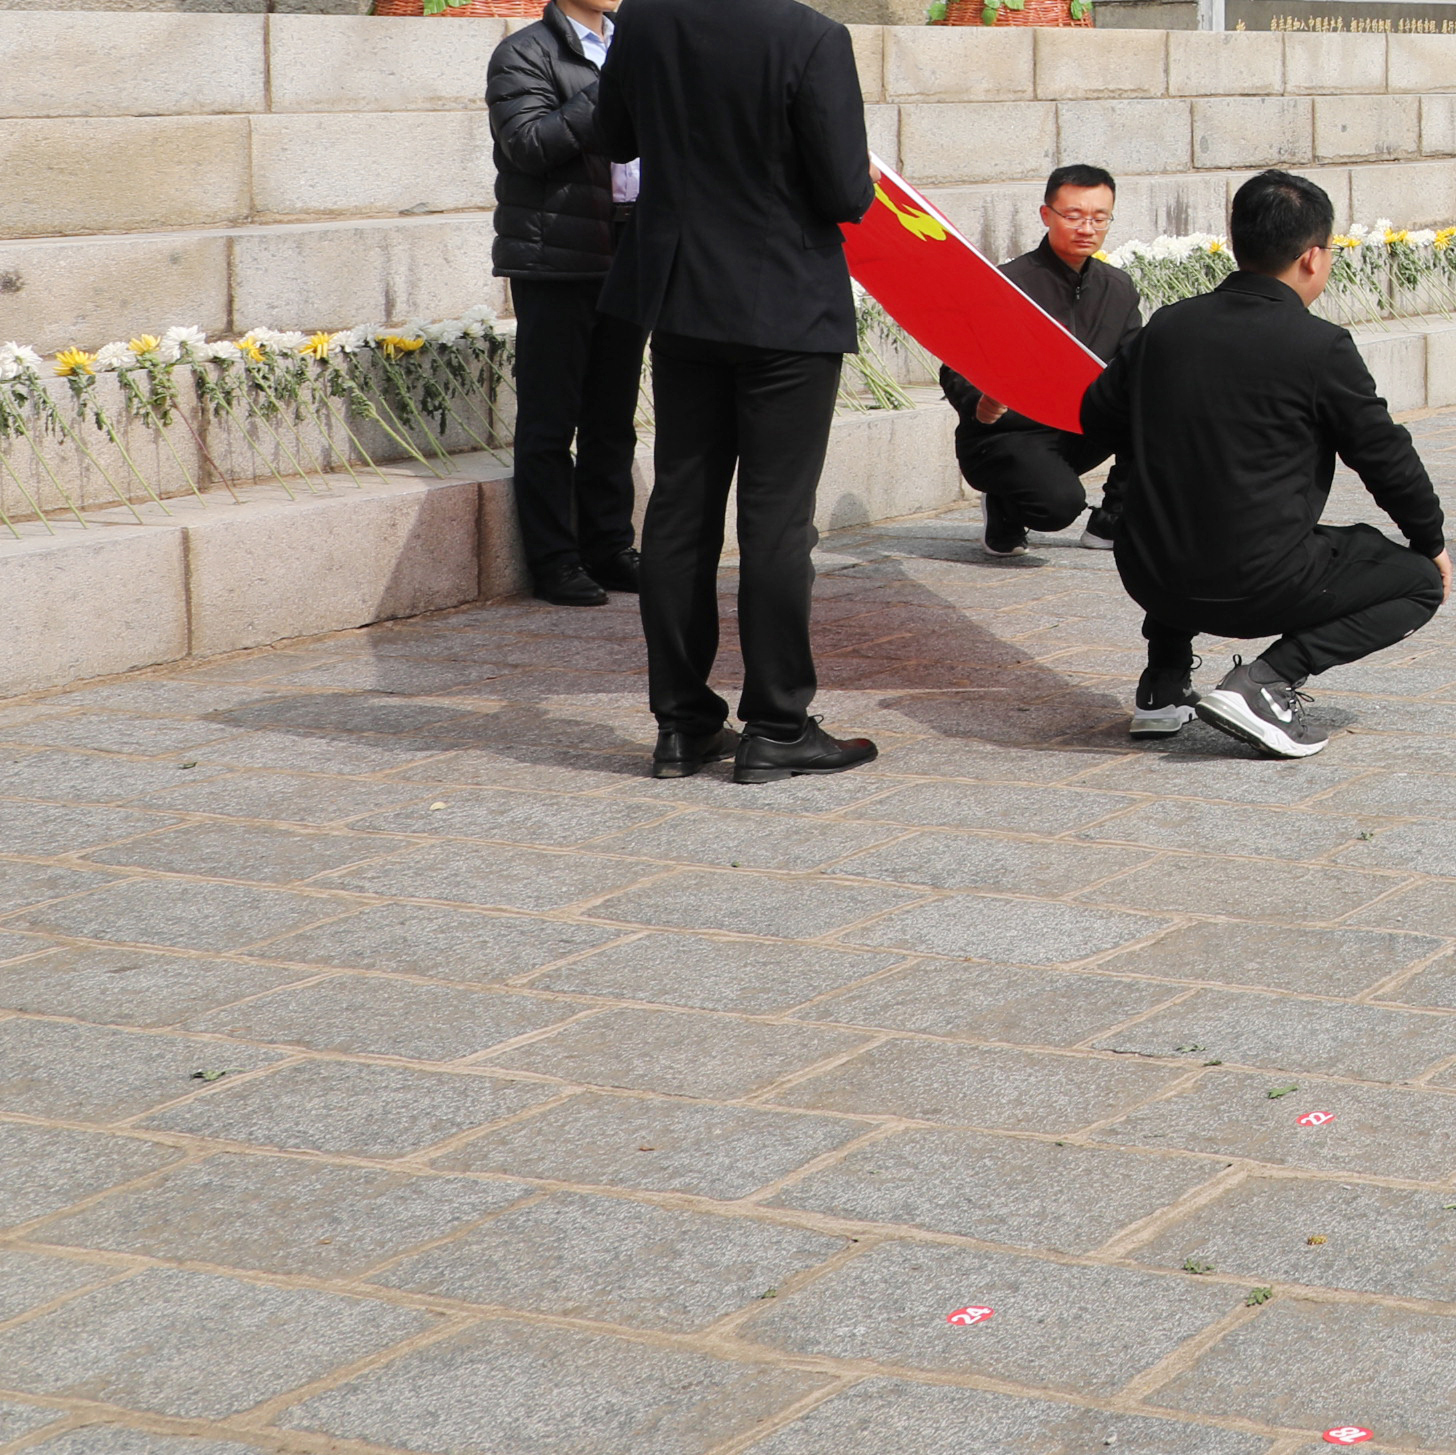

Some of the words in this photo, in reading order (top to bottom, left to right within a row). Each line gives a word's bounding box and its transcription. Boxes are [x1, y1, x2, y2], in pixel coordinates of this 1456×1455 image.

[1301, 1113, 1334, 1126] 22
[951, 1307, 991, 1325] 24
[1329, 1426, 1367, 1444] 18
